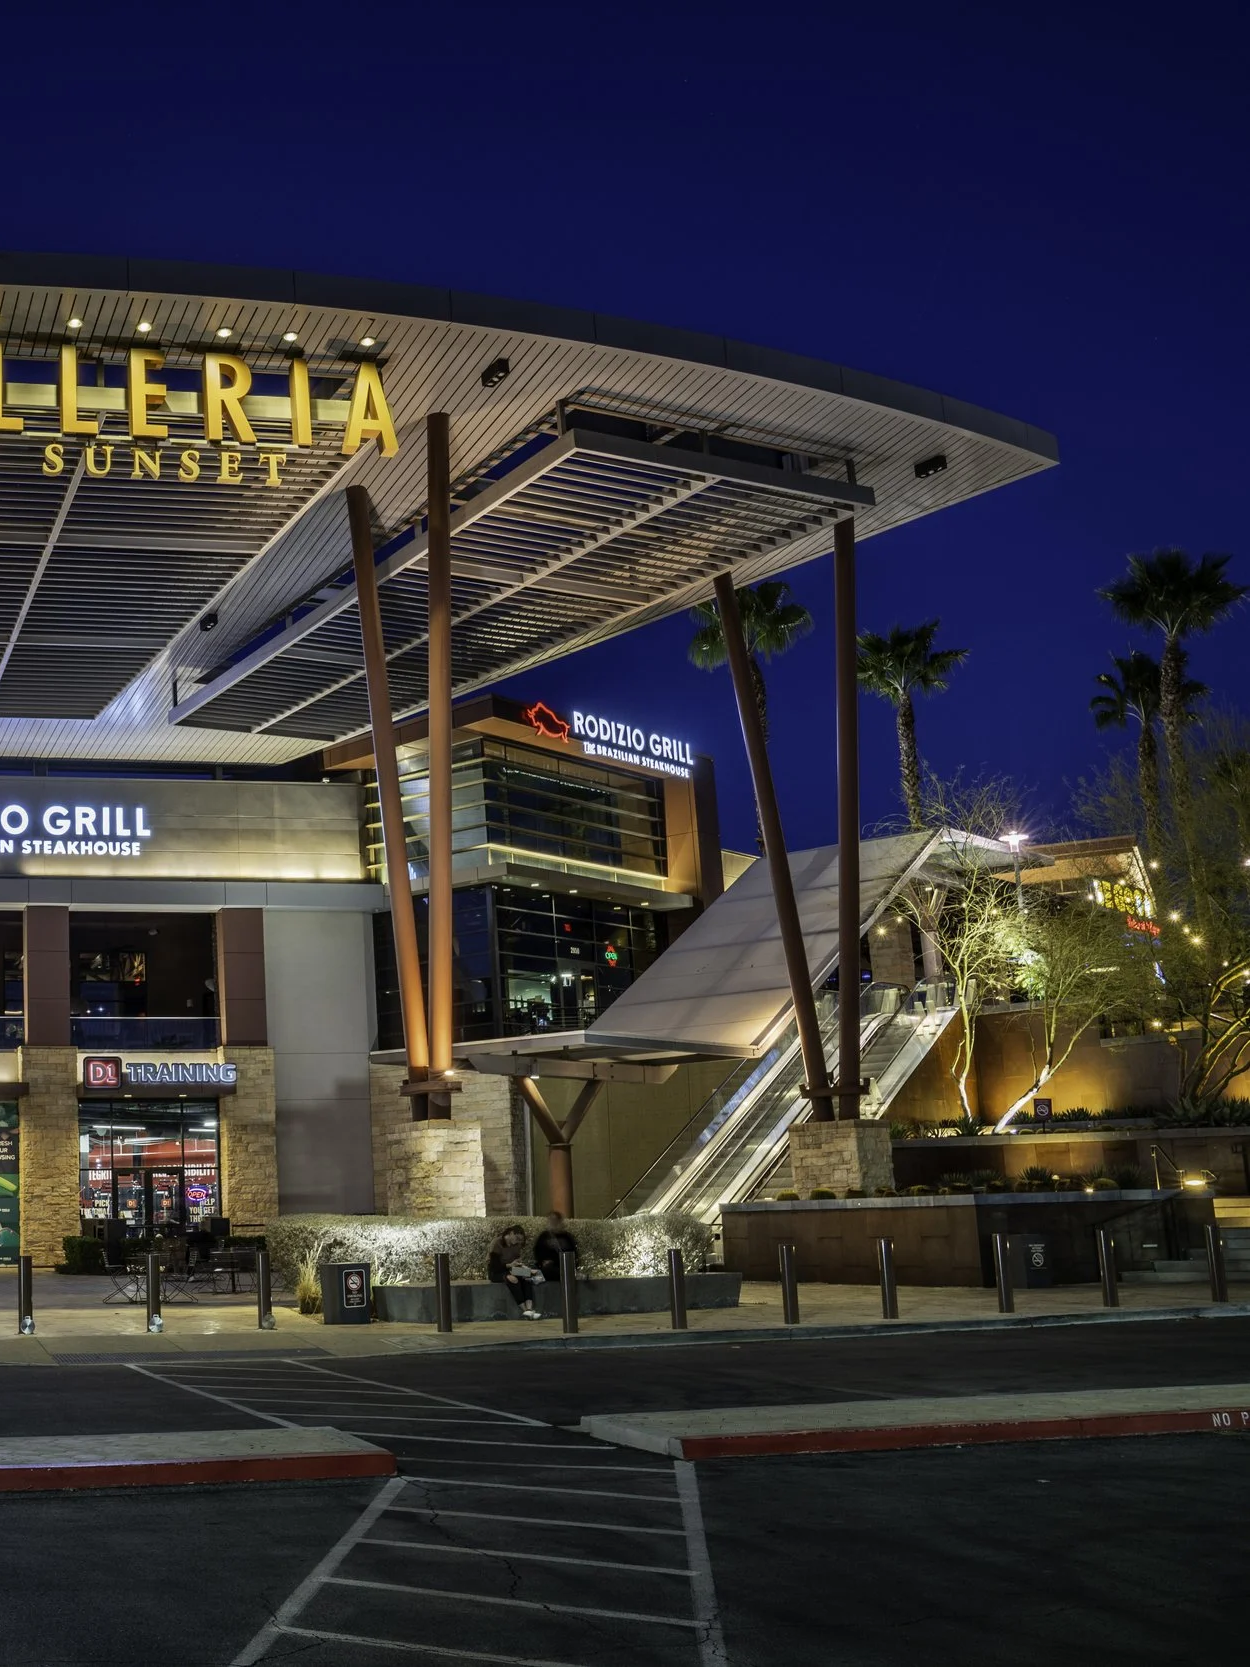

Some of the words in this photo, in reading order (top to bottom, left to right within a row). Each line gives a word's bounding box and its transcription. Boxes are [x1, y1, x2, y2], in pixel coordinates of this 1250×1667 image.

[42, 443, 287, 487] SUNSET
[573, 710, 645, 751] RODIZIO
[650, 733, 694, 766] GRILL
[596, 744, 640, 765] BRAZILIAN
[642, 756, 690, 779] STEAKHOUSE
[42, 804, 151, 837] GRILL
[21, 840, 141, 856] STEAKHOUSE
[89, 1061, 118, 1084] D1
[126, 1063, 238, 1084] TRAINING
[94, 1199, 110, 1208] PICK
[187, 1191, 206, 1199] OPEN
[1212, 1412, 1231, 1427] NO
